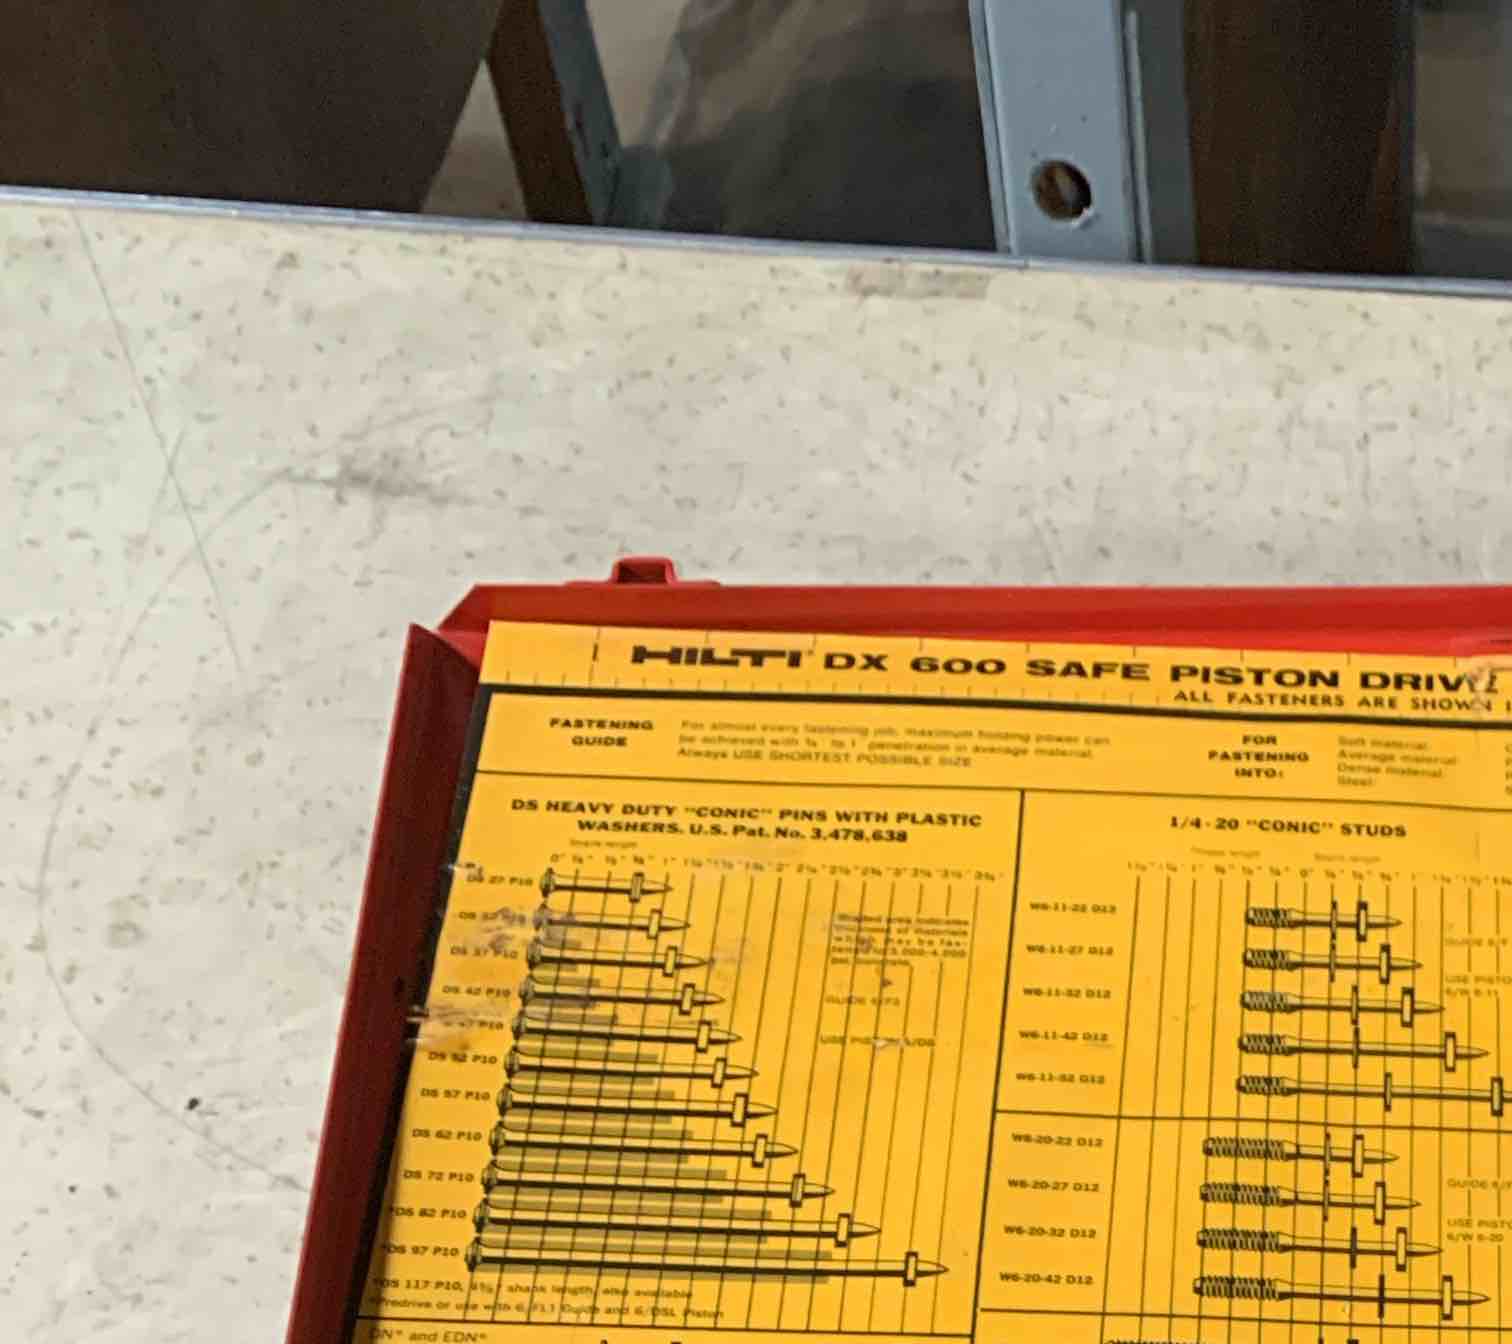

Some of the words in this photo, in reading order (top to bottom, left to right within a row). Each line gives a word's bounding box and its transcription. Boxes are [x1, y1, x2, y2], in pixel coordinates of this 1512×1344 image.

[632, 646, 801, 668] HILTI
[824, 653, 888, 671] DX
[911, 657, 1006, 674] 600
[1027, 659, 1149, 680] SAFE
[1170, 665, 1339, 689] PISTON
[1173, 690, 1212, 703] ALL
[1228, 691, 1344, 708] FASTENERS
[1358, 695, 1398, 709] ARE
[1411, 696, 1492, 712] SHOWN
[549, 717, 654, 731] FASTENING
[571, 735, 628, 747] GUIDE
[1242, 735, 1277, 745] FOR
[1208, 751, 1309, 762] FASTENING
[512, 799, 538, 811] DS
[546, 800, 614, 815] HEAVY
[622, 804, 676, 816] DUTY
[685, 805, 772, 820] "CONIC"
[780, 809, 828, 822] PINS
[836, 811, 888, 824] WITH
[896, 812, 982, 827] PLASTIC
[1169, 816, 1200, 829] 1/4
[1216, 818, 1239, 831] 20
[1247, 820, 1333, 834] "CONIC"
[1341, 823, 1407, 837] STUDS
